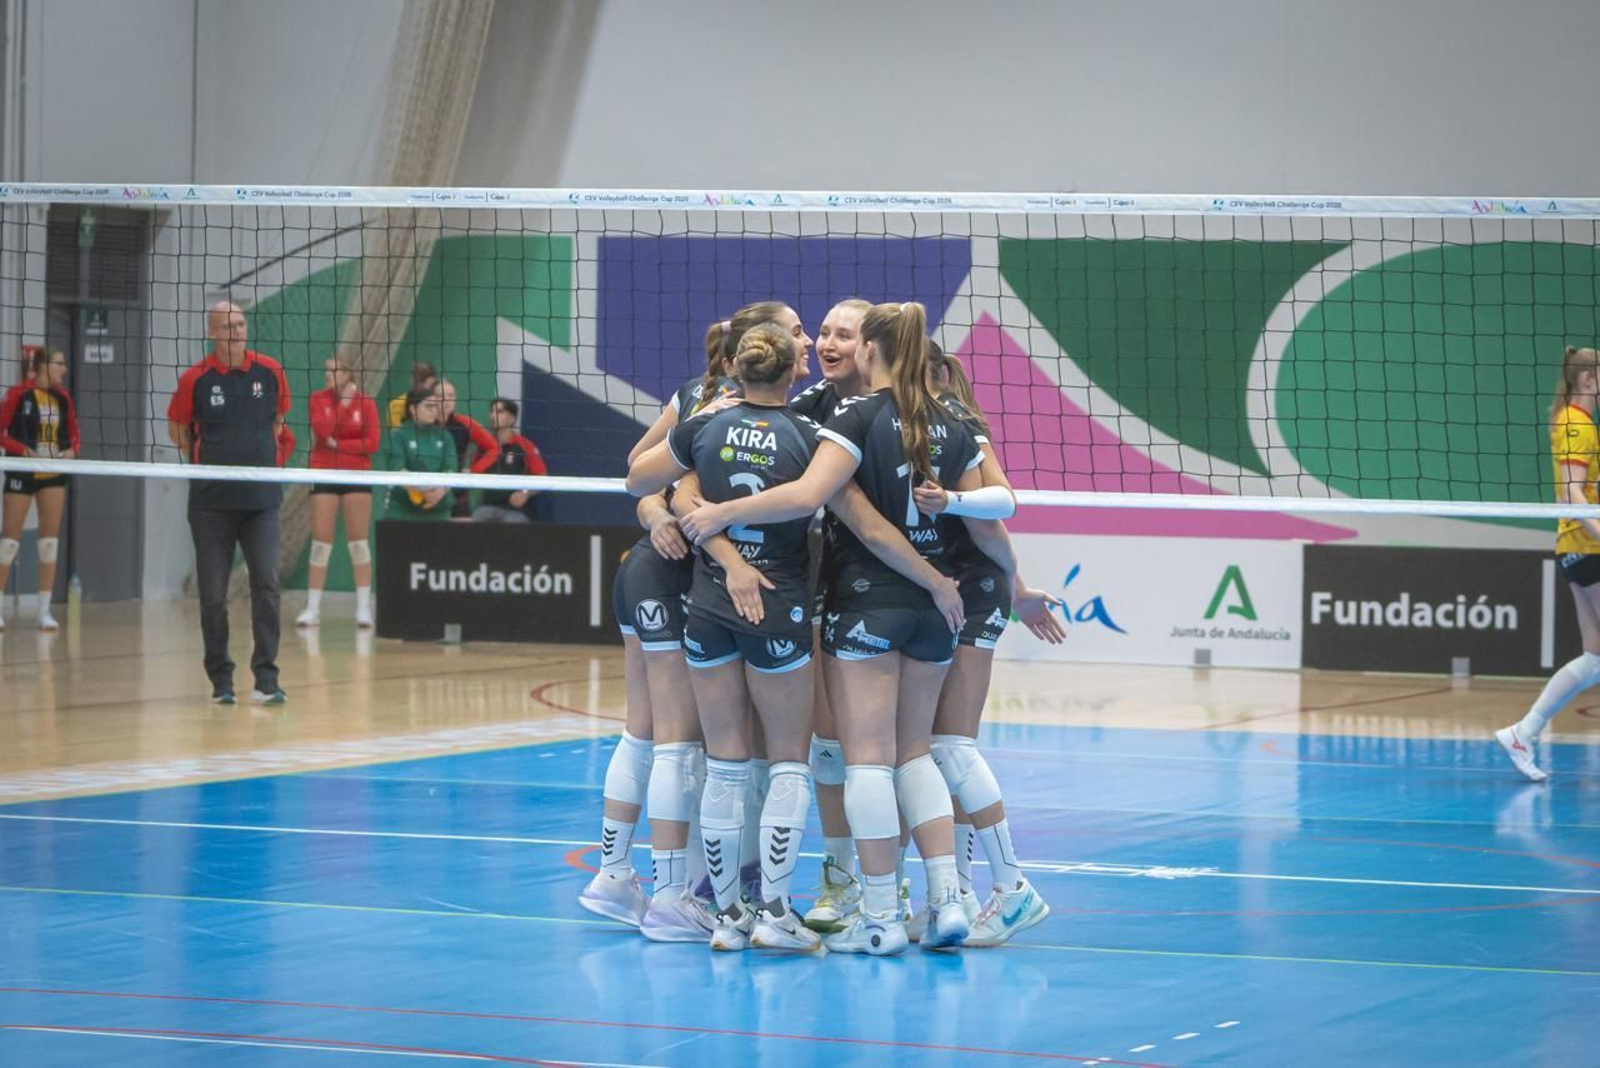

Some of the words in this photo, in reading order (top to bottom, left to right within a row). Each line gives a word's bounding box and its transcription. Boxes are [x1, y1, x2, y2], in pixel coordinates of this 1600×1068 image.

[1229, 200, 1243, 209] CEV
[1244, 200, 1275, 209] Volleyball
[1277, 200, 1310, 209] Challenge
[1311, 200, 1325, 209] Cup
[725, 426, 777, 451] KIRA
[736, 451, 775, 466] ERGOS
[729, 472, 765, 544] 2
[410, 563, 572, 594] Fundación
[1311, 591, 1518, 629] Fundación
[1170, 625, 1206, 638] Junta
[1209, 626, 1225, 639] de
